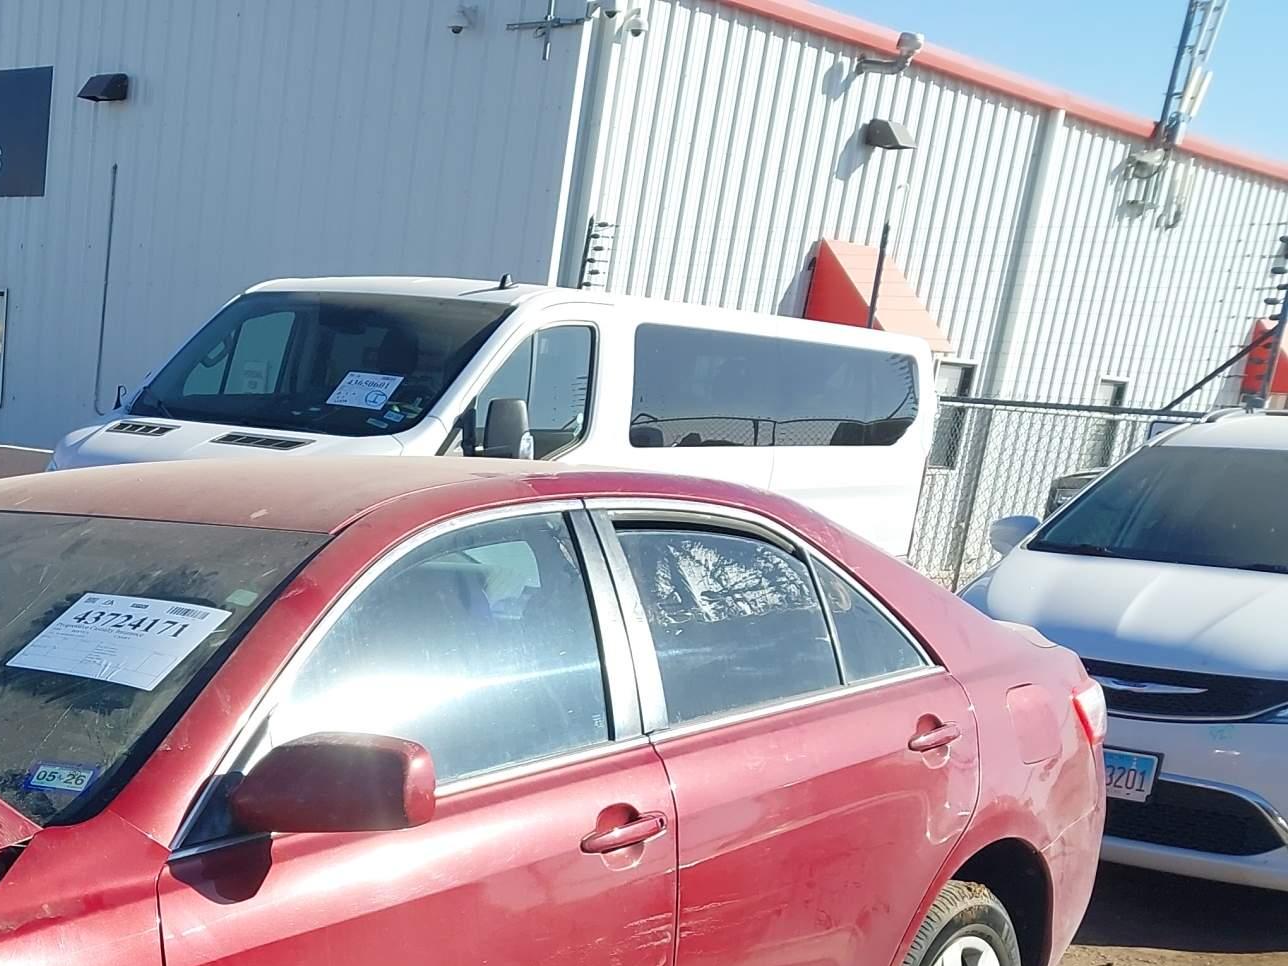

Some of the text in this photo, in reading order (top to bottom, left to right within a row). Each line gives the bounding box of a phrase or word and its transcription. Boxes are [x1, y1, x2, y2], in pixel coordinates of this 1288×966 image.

[72, 609, 191, 638] 43724171
[36, 770, 87, 786] 05 26
